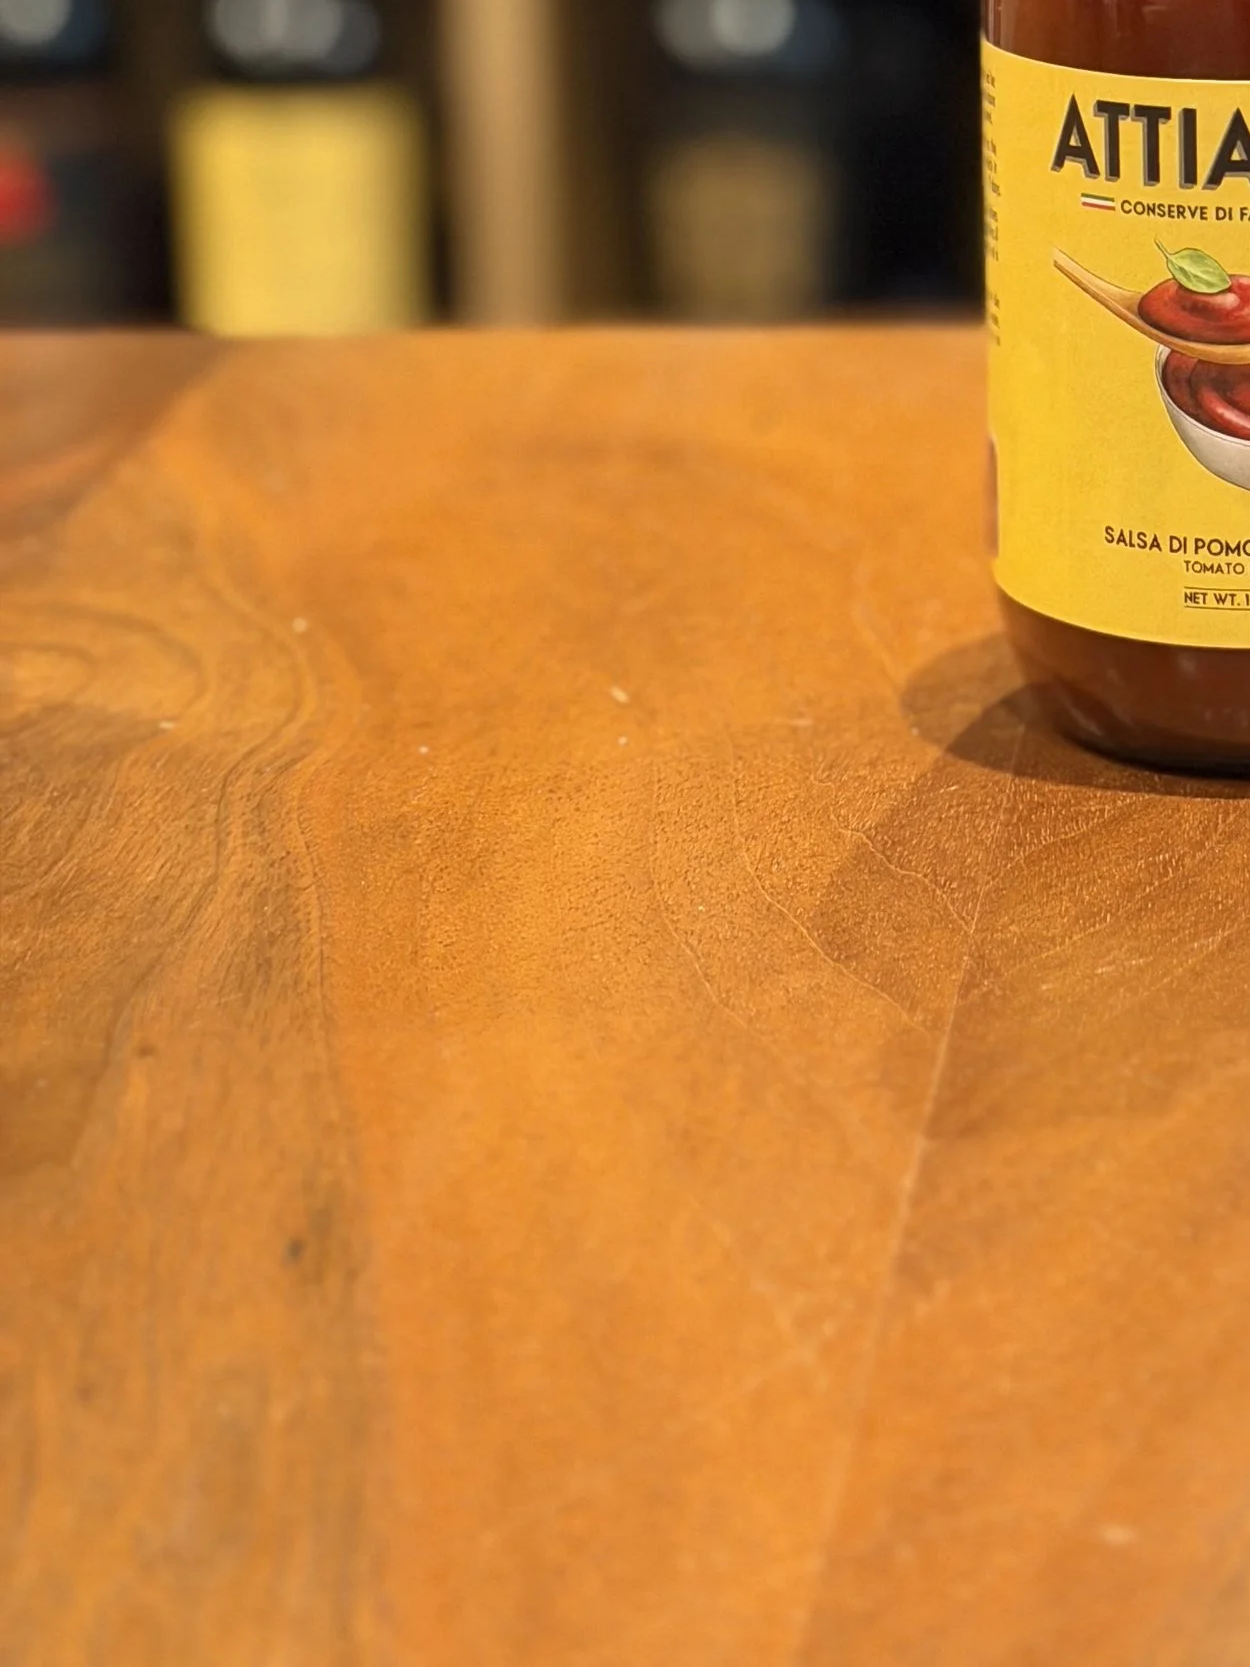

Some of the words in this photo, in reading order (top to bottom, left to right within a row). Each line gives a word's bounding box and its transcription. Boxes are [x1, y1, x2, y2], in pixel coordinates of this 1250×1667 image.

[1120, 199, 1208, 222] CONSERVE
[1214, 206, 1234, 222] DI
[1104, 525, 1162, 553] SALSA
[1168, 535, 1188, 555] DI
[1183, 559, 1245, 575] TOMATO
[1184, 591, 1208, 605] NET
[1213, 592, 1241, 606] WT.
